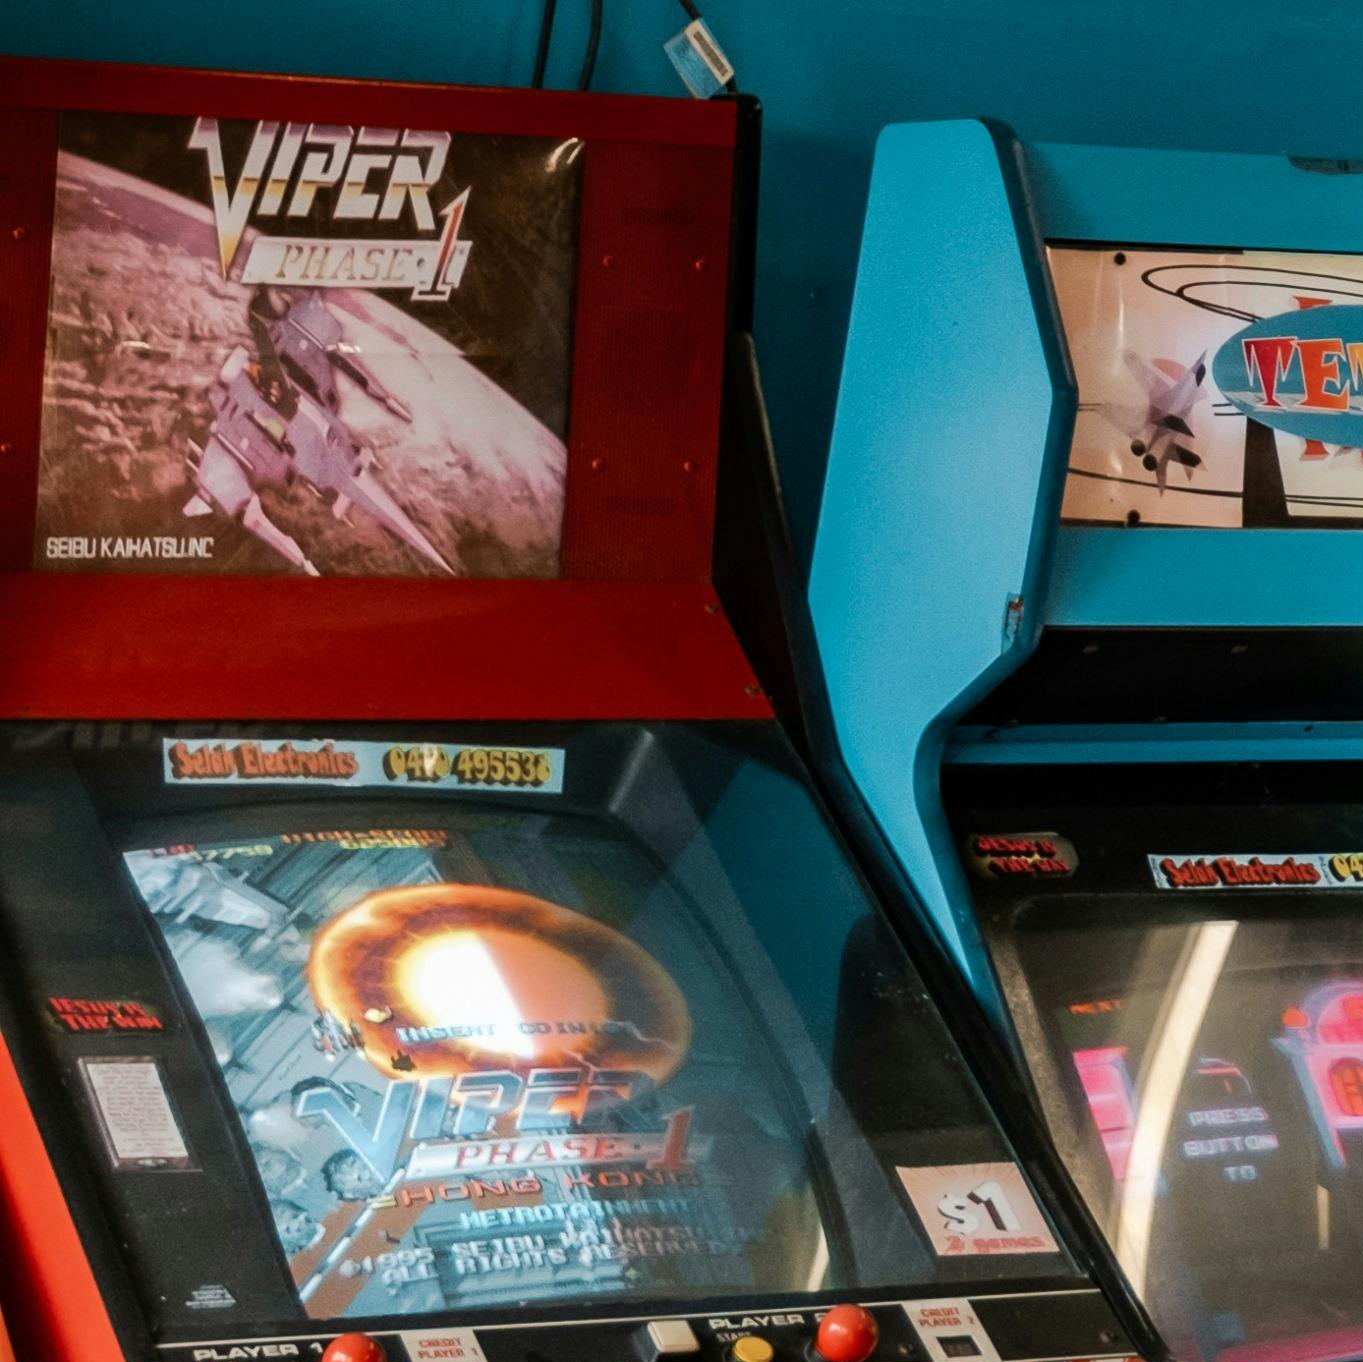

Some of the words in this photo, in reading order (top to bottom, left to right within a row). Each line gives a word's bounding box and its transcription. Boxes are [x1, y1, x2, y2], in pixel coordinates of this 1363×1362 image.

[187, 116, 451, 280] VIPER
[275, 244, 413, 281] PHASE
[47, 536, 96, 559] SEIBU
[235, 740, 359, 780] Electronics
[1212, 856, 1321, 886] Electronics
[395, 1021, 499, 1044] INSERT
[454, 1136, 624, 1170] PHASE
[402, 1179, 542, 1207] HONG
[945, 1236, 966, 1252] 2
[971, 1236, 1045, 1253] games
[708, 1313, 805, 1330] PLAYER
[193, 1343, 299, 1361] PLAYER
[417, 1348, 465, 1360] PLAYER
[418, 1337, 463, 1348] CREDIT
